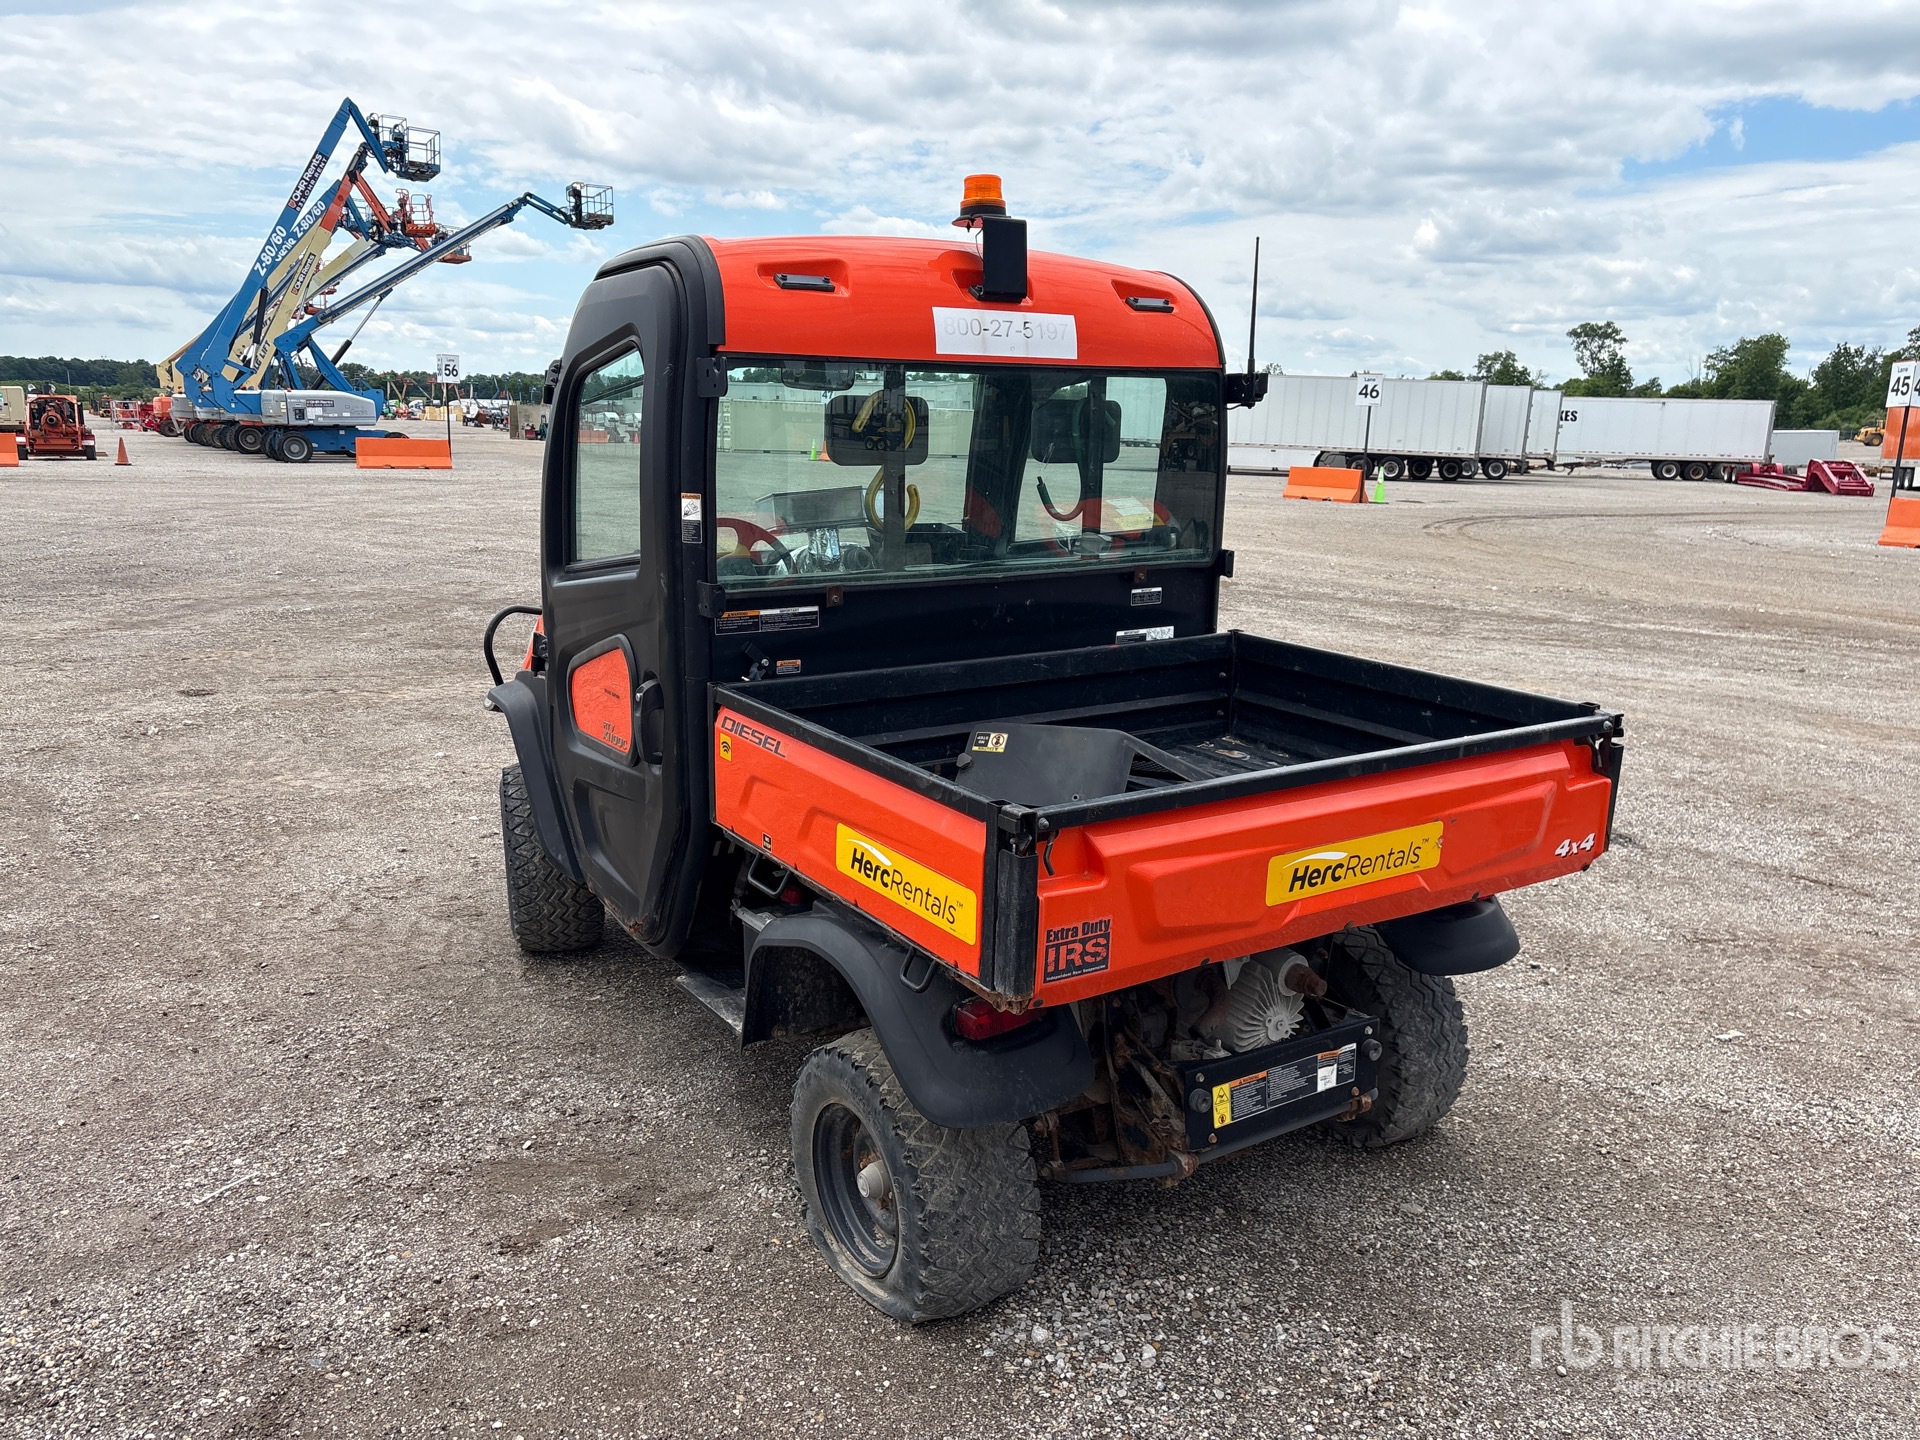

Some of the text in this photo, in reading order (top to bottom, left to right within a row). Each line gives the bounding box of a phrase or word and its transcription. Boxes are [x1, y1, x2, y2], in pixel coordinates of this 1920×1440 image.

[292, 152, 323, 202] OHR Rents
[293, 201, 326, 238] Z-80/60
[254, 225, 287, 276] Z-80/60
[943, 316, 1069, 341] 800-27-5197
[260, 339, 271, 360] LIFT
[444, 363, 459, 378] 56
[1358, 384, 1380, 399] 46
[1891, 375, 1911, 397] 45
[721, 716, 786, 758] DIESEL
[1555, 833, 1596, 858] 4x4
[1046, 918, 1111, 943] Extra Duty
[1047, 937, 1107, 973] IRS
